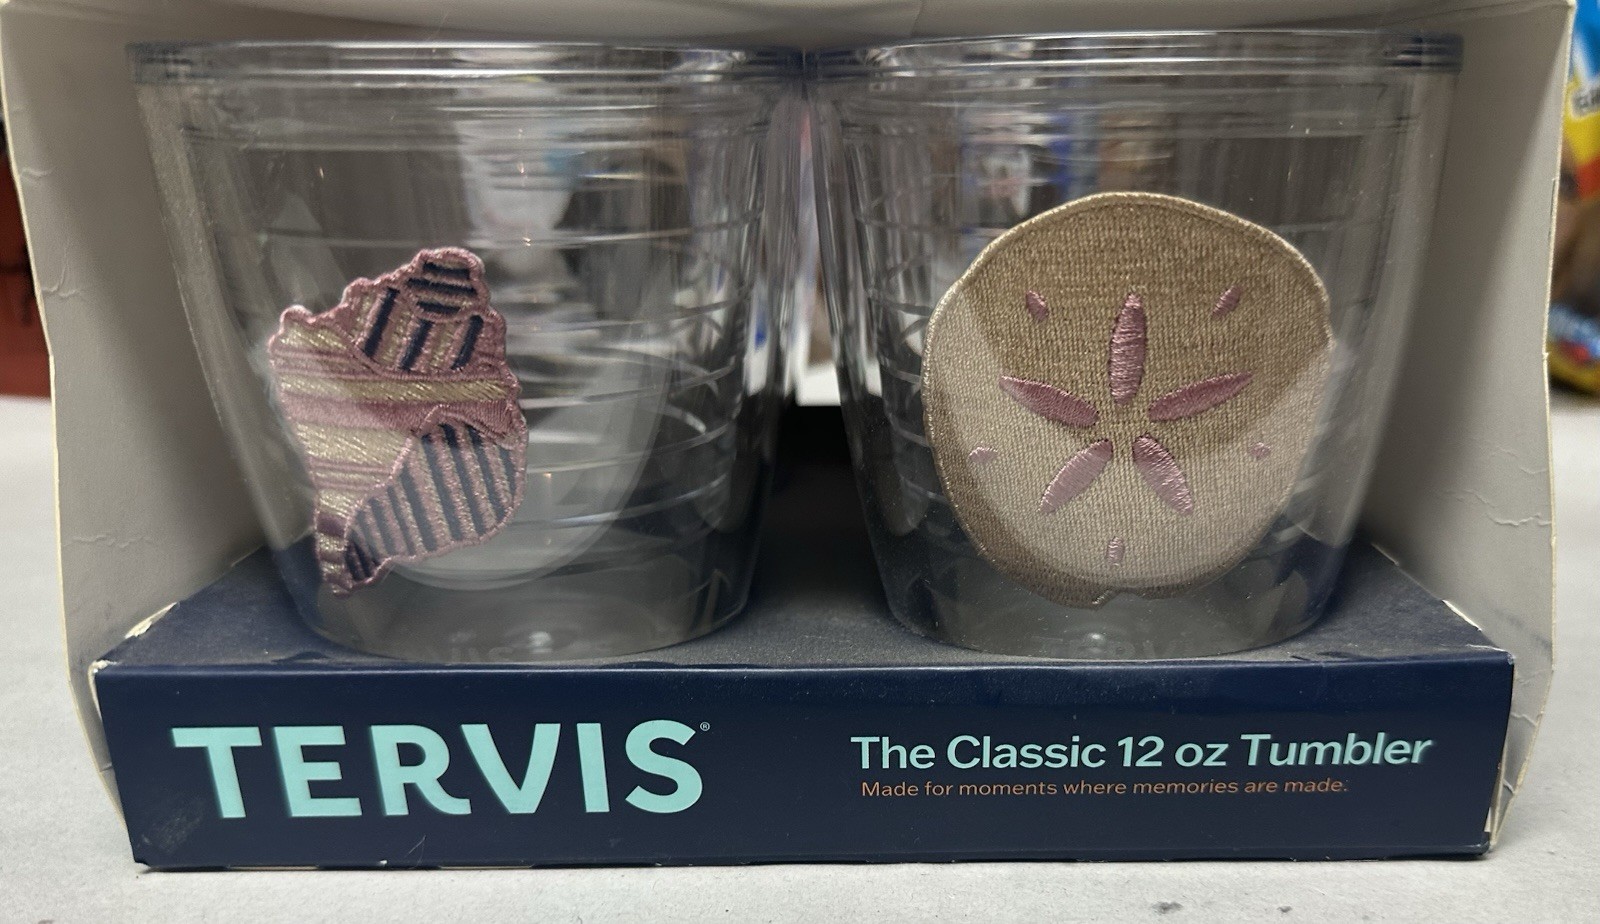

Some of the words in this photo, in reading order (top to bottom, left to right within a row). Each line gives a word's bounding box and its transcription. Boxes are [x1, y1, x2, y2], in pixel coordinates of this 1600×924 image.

[850, 736, 936, 769] The
[946, 735, 1107, 769] Classic
[1117, 735, 1164, 768] 12
[1174, 742, 1229, 768] oz
[1240, 732, 1434, 767] Tumbler
[861, 780, 919, 797] Made
[924, 780, 954, 796] for
[959, 781, 1057, 796] moments
[1063, 780, 1127, 795] where
[1132, 779, 1238, 795] memories
[1244, 781, 1278, 793] are
